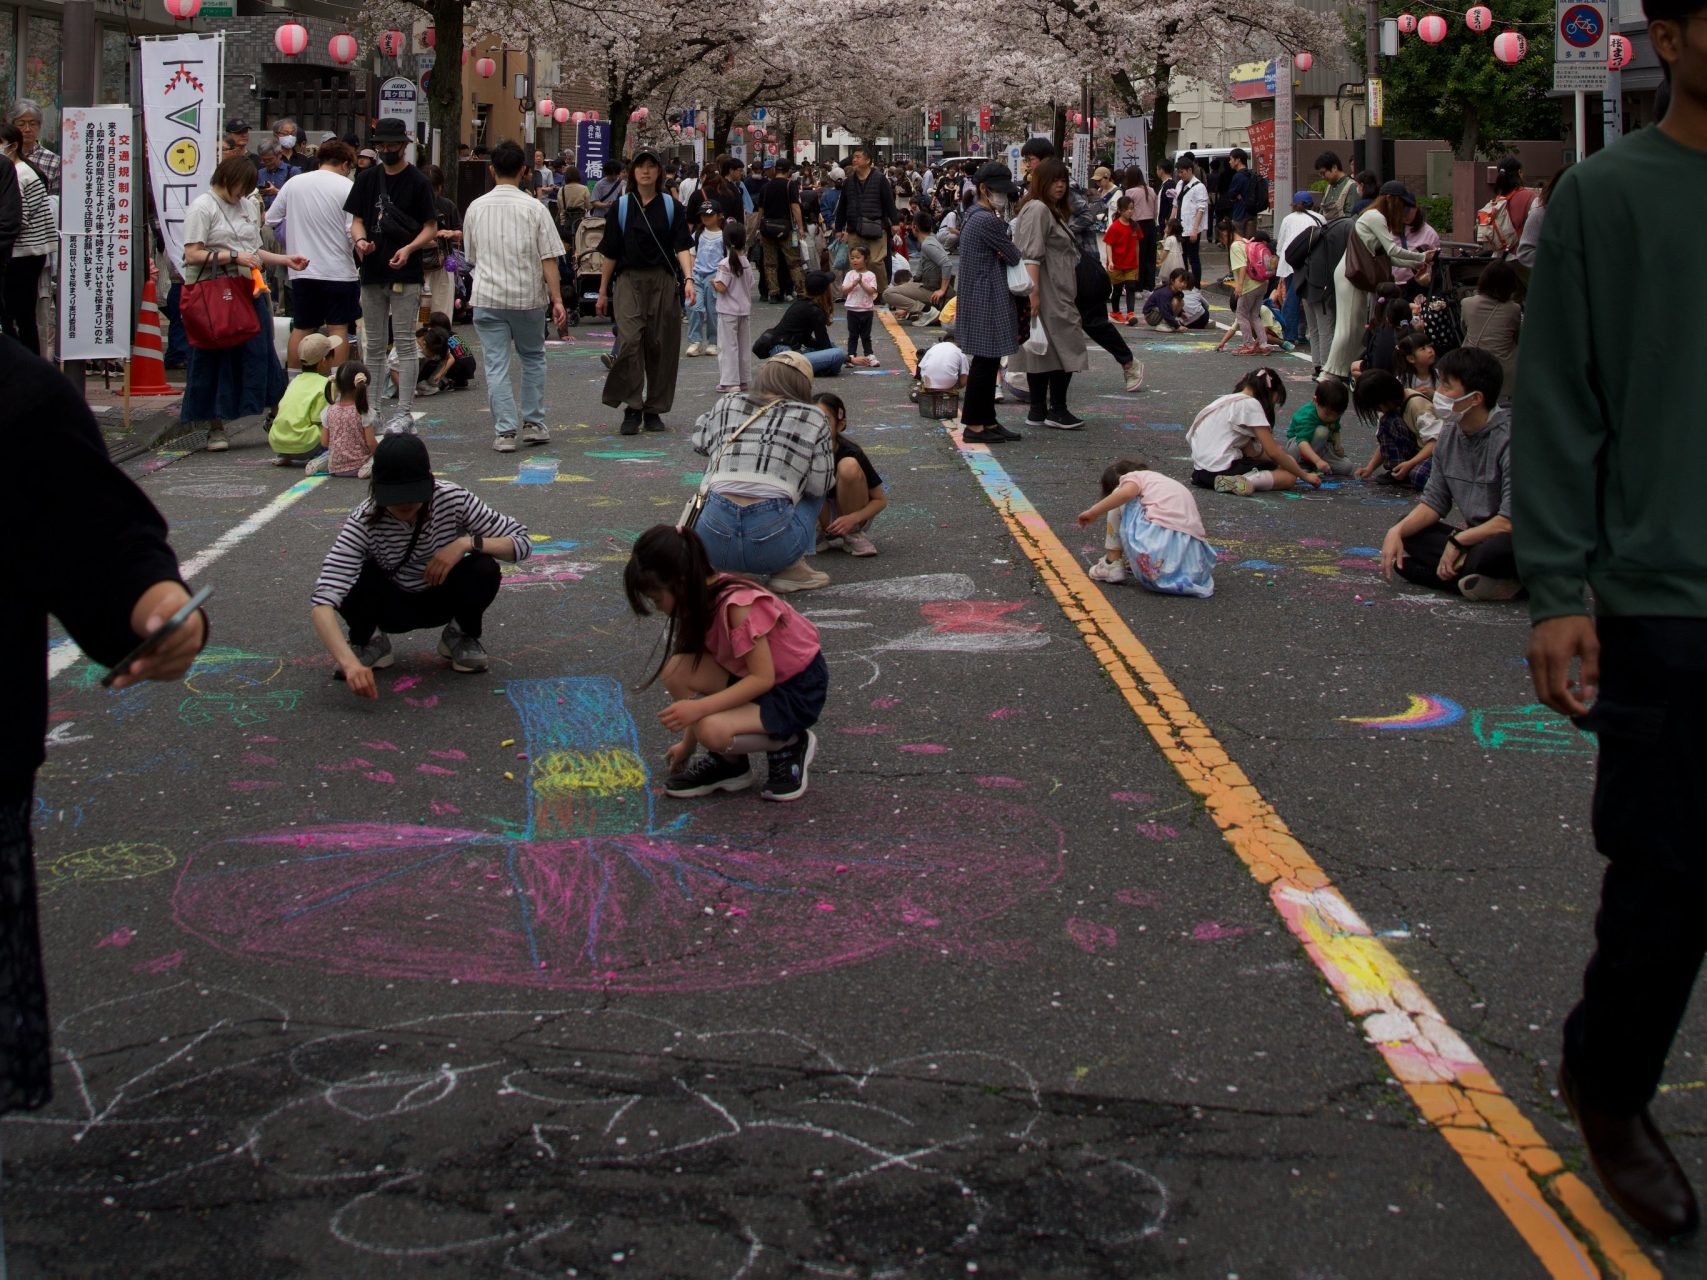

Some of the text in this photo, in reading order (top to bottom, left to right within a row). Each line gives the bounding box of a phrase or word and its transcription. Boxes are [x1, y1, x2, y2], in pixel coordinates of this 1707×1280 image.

[1565, 50, 1600, 59] 多摩市
[585, 141, 603, 179] 三橋
[118, 135, 130, 272] 交通規制のお知らせ
